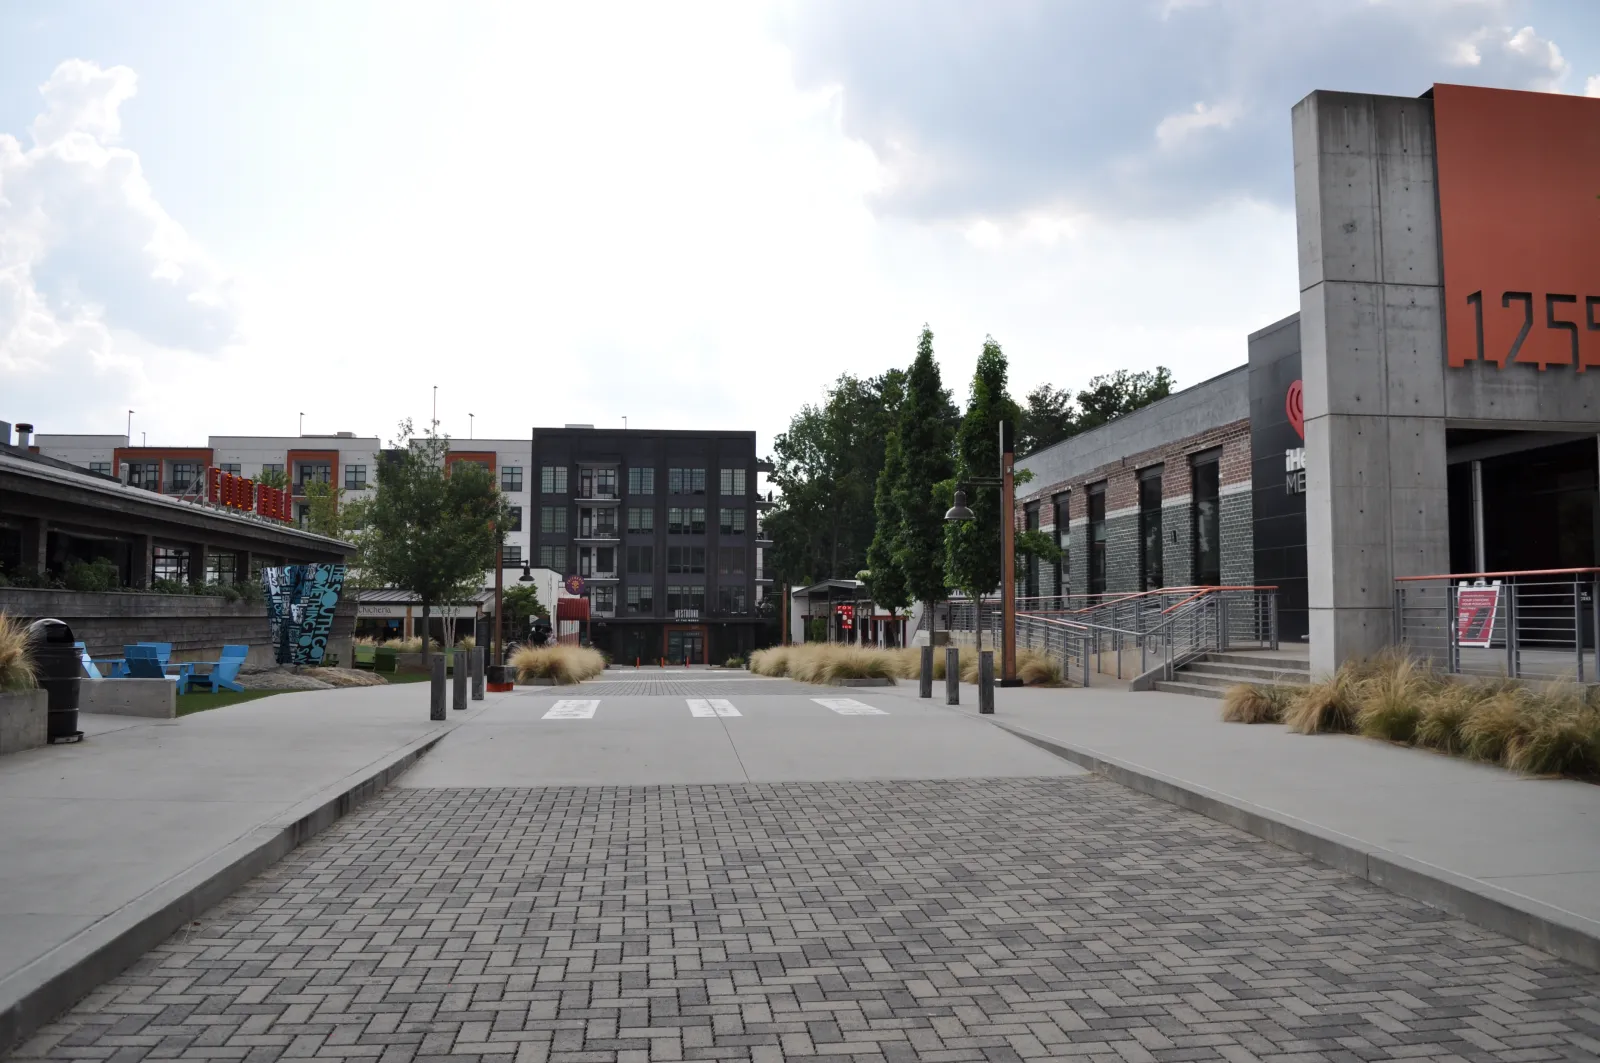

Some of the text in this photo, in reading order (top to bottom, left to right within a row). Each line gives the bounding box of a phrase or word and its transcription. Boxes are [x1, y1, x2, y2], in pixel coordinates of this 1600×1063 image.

[303, 563, 331, 630] SOMETHING
[308, 564, 345, 665] THE SOUTH GOT
